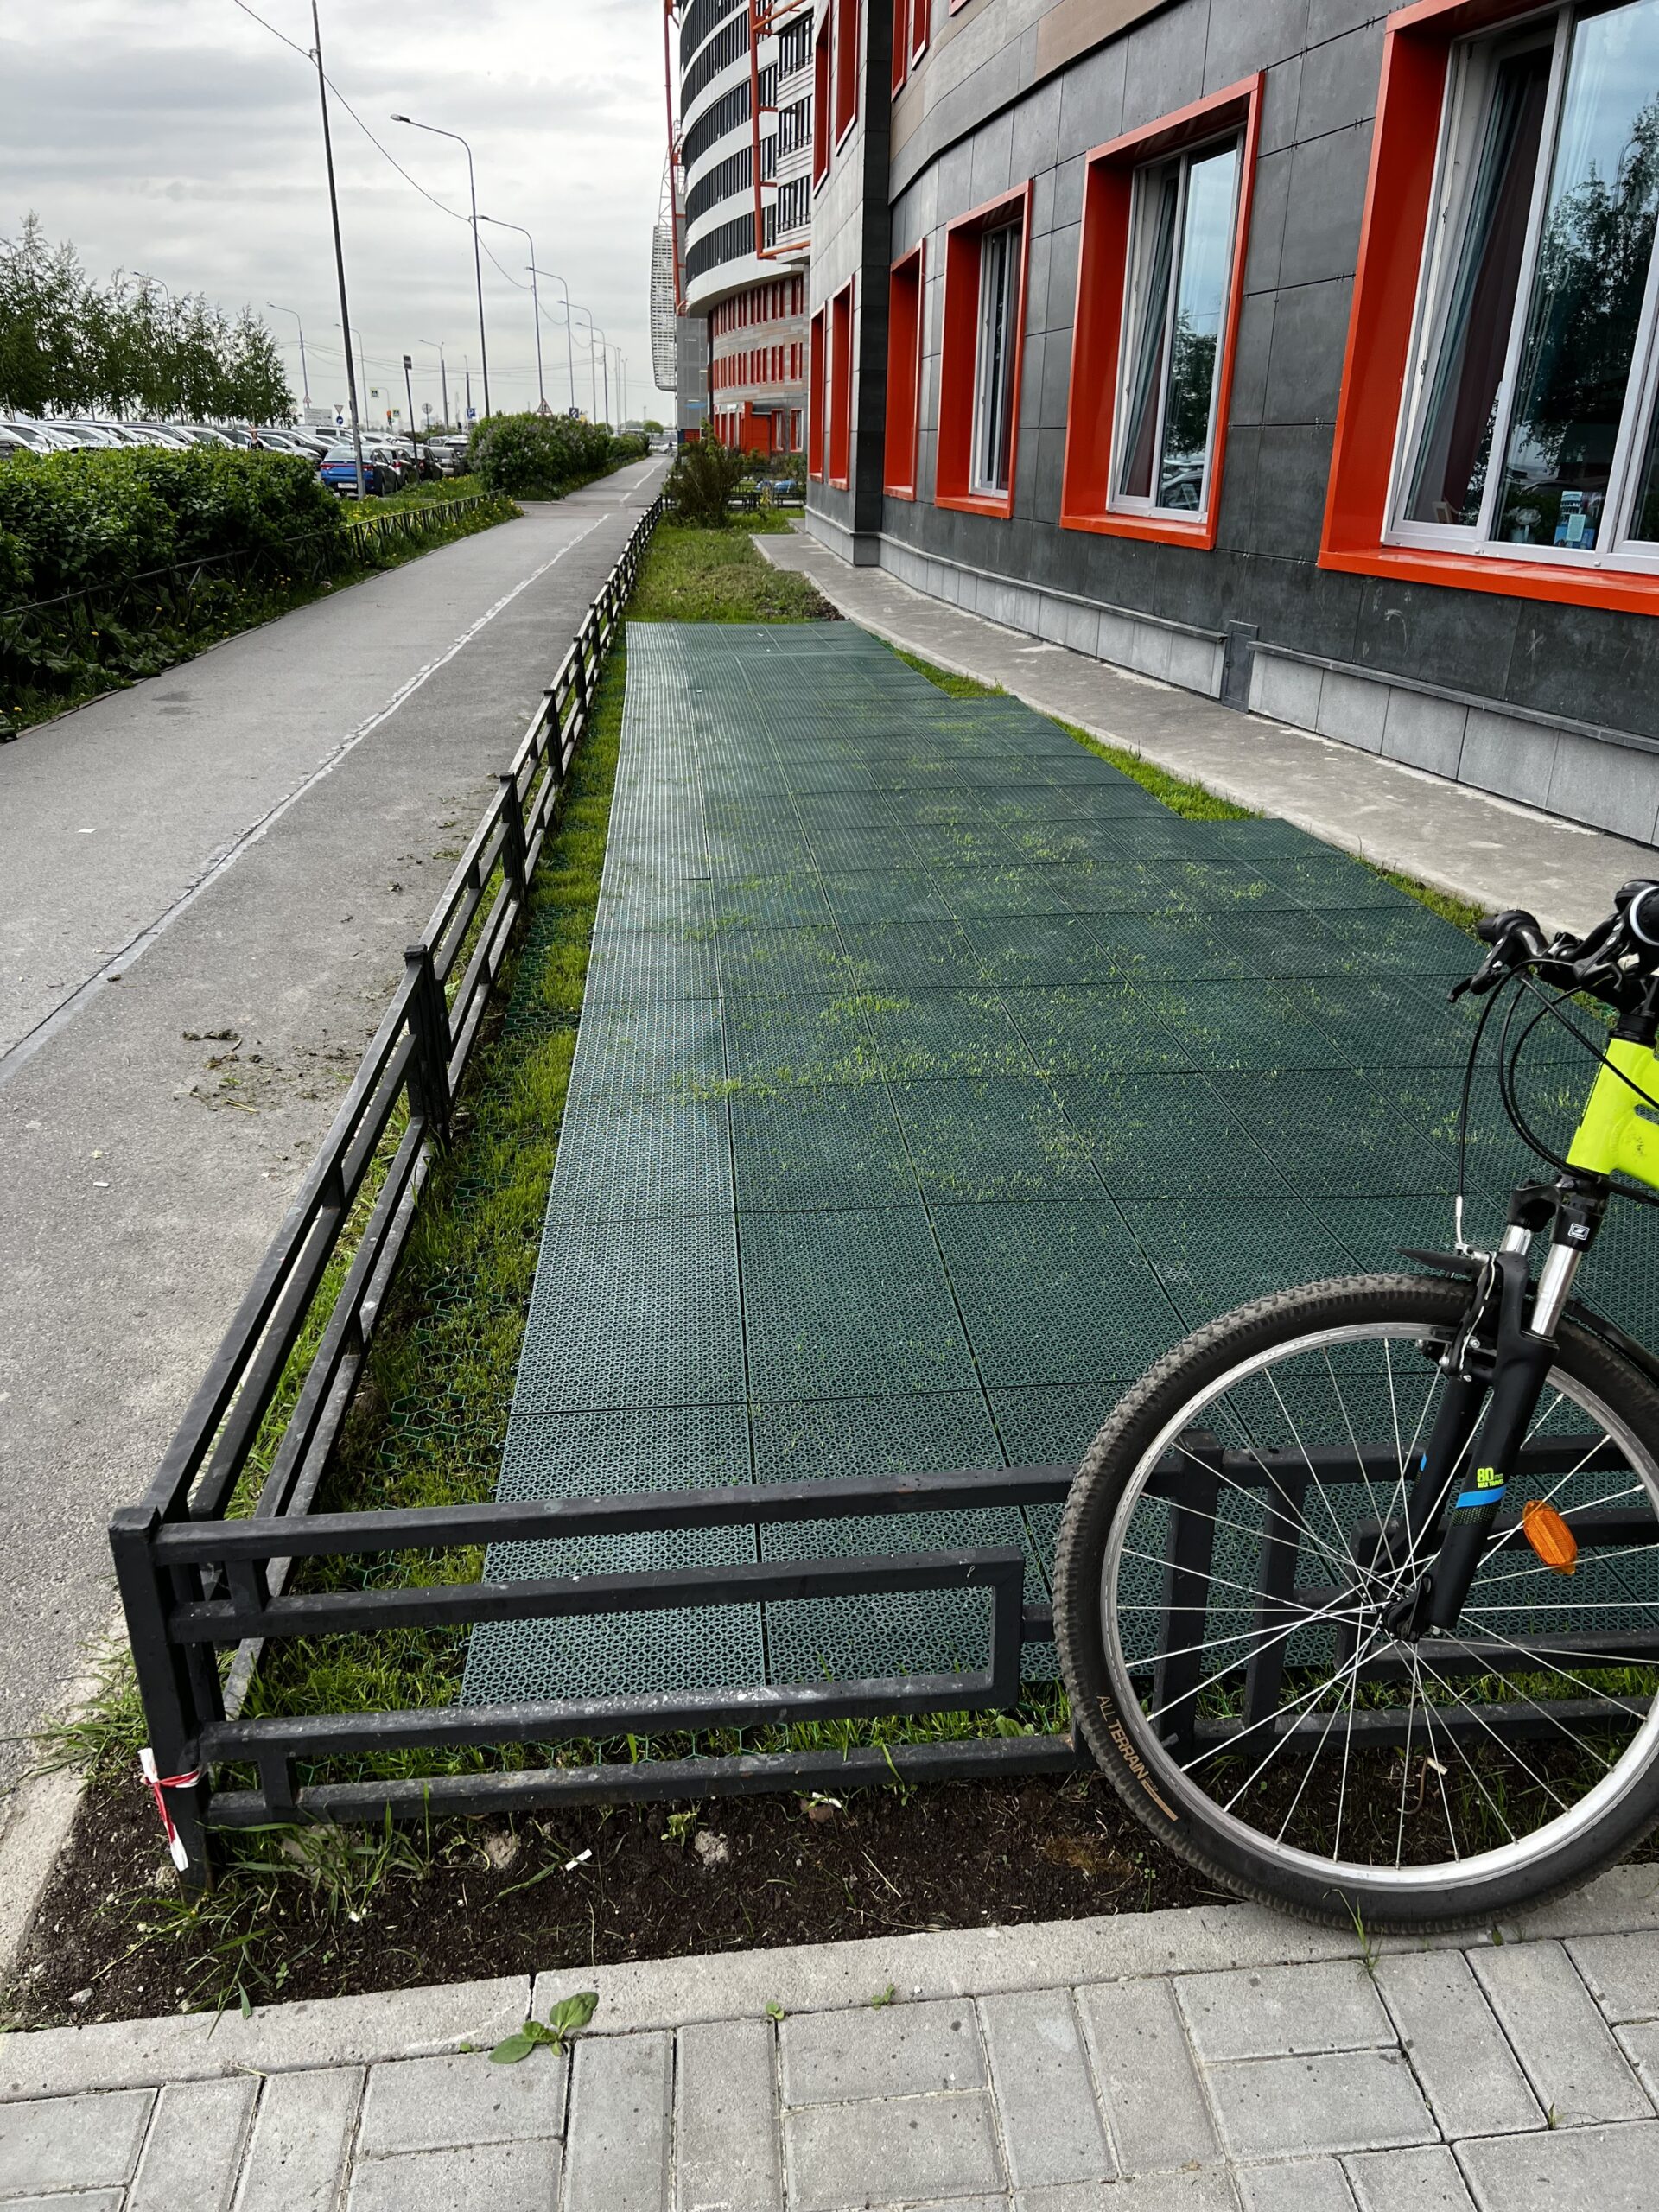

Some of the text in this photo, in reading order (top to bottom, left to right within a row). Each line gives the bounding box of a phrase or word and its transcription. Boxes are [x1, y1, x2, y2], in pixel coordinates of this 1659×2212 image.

[1477, 1467, 1494, 1483] 80
[1489, 1478, 1504, 1487] TRAVEL
[1096, 1695, 1150, 1780] ALL TERRAIN
